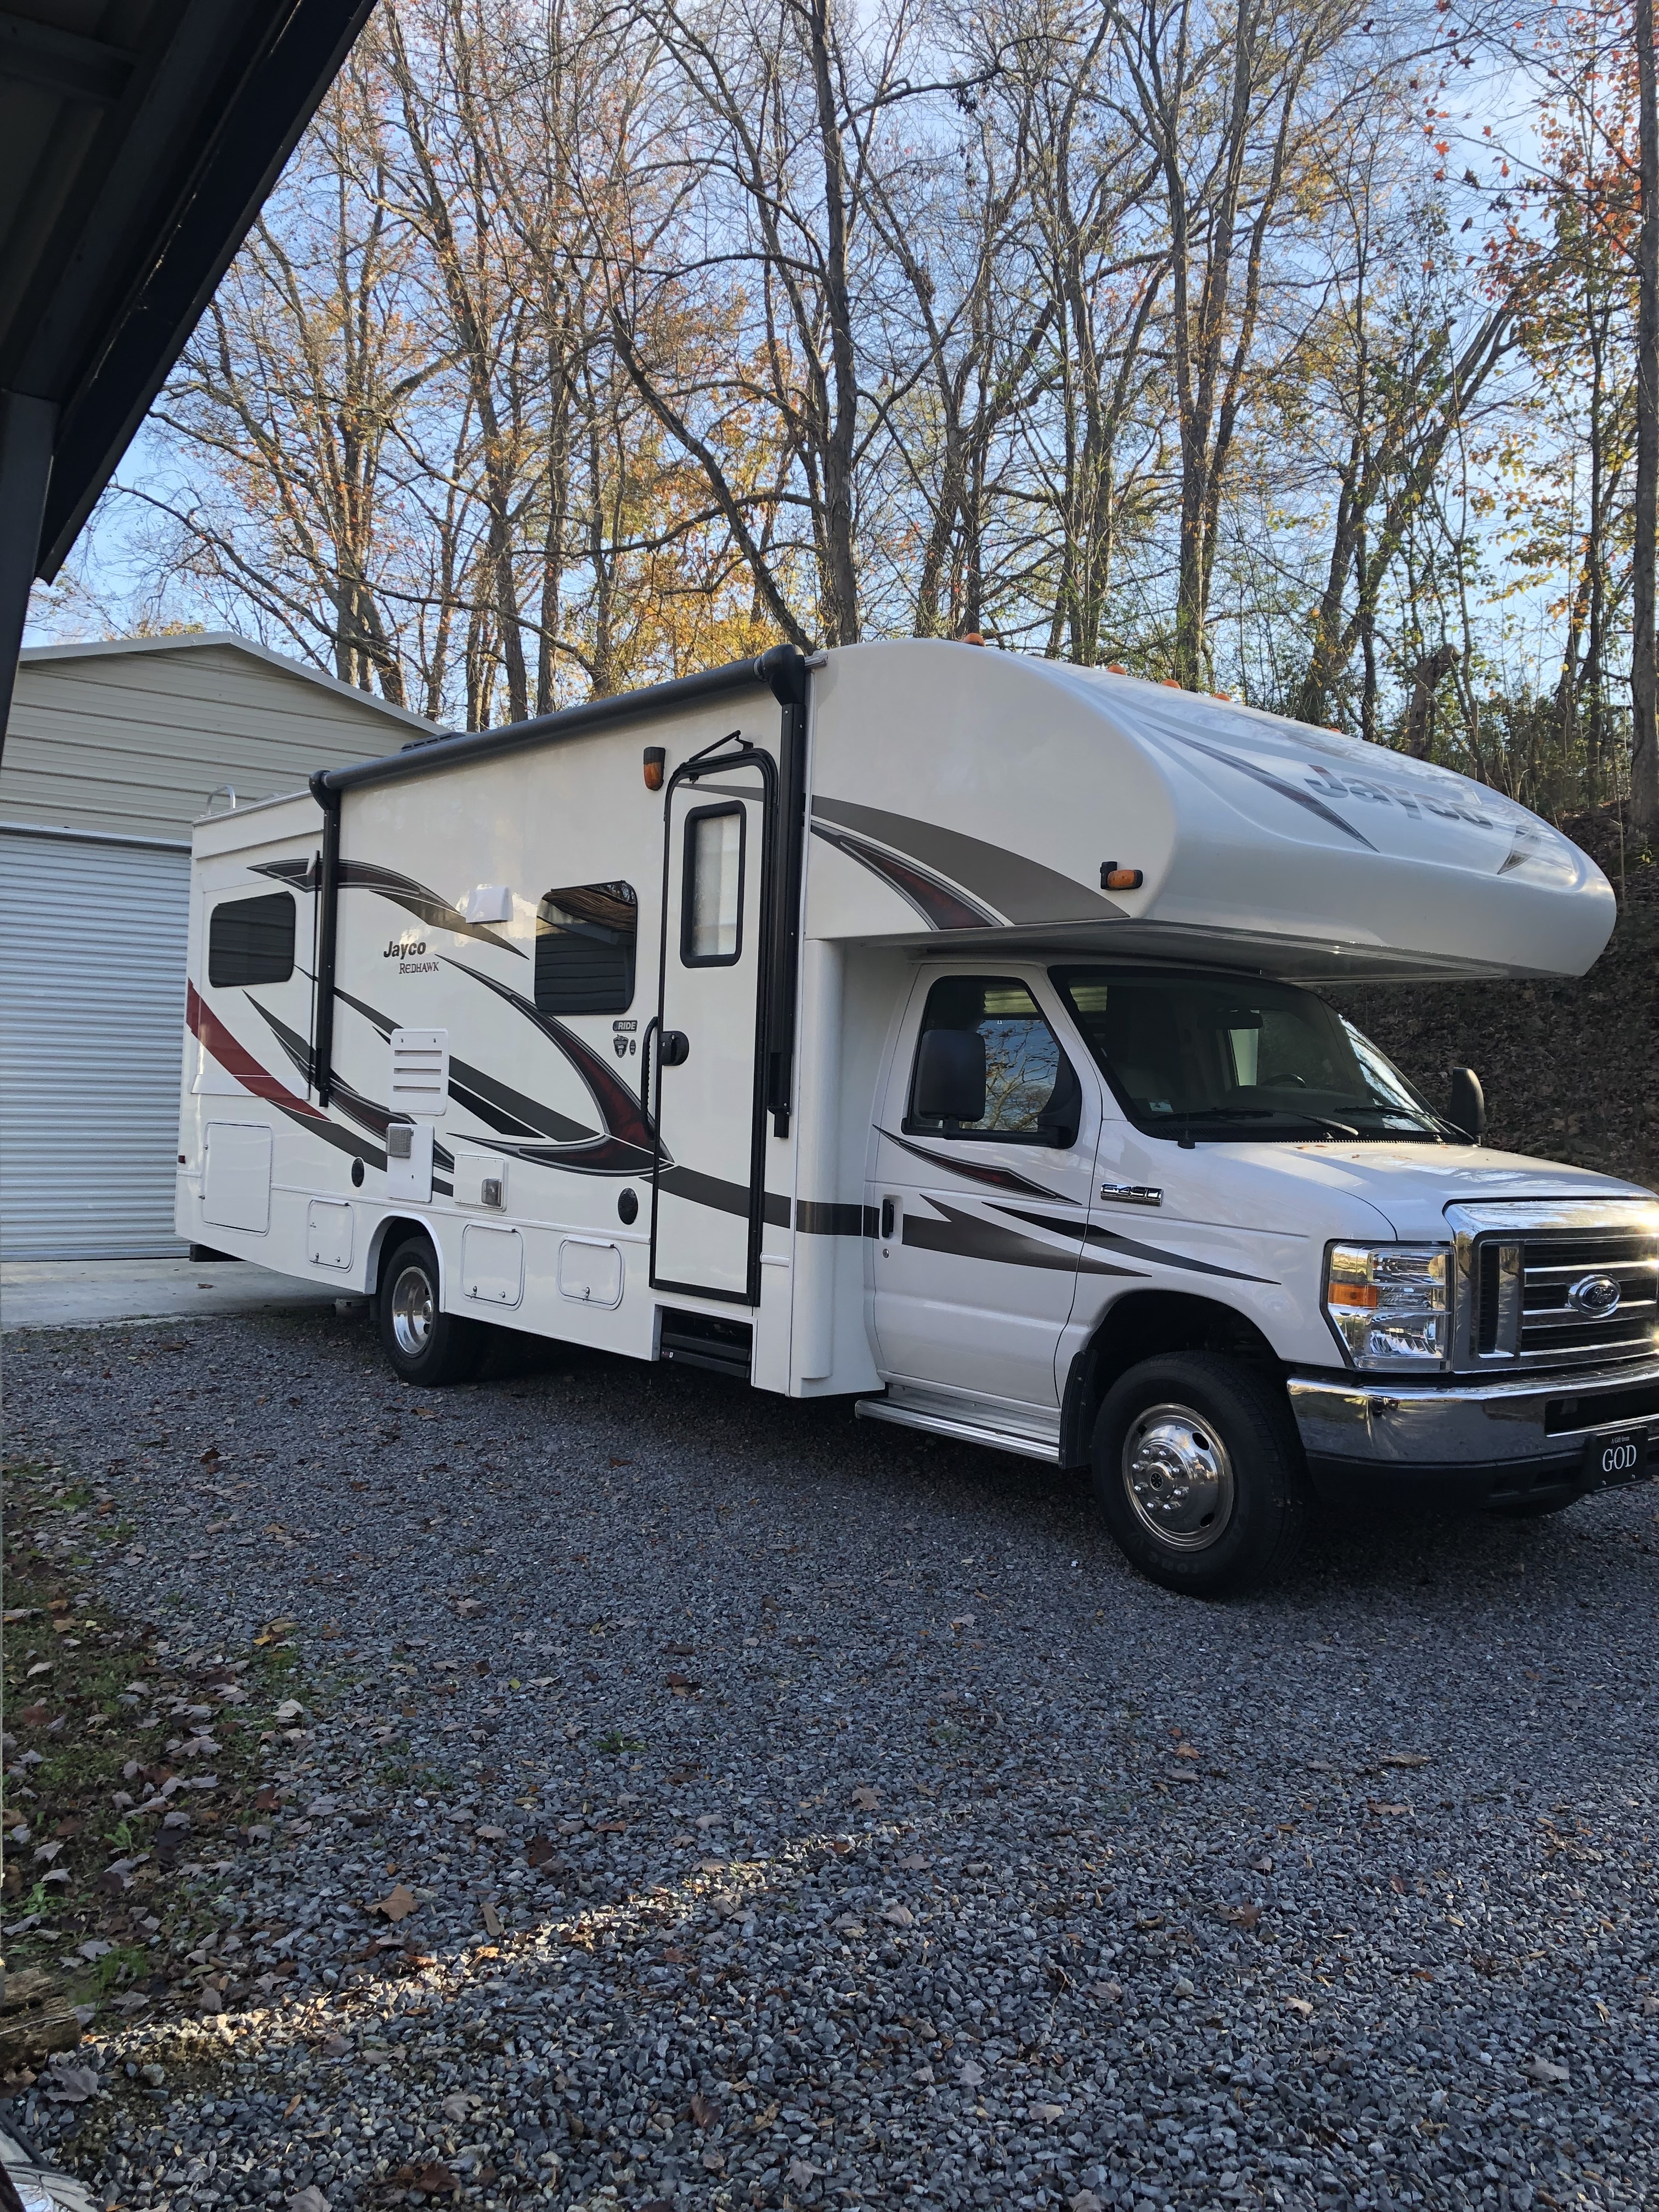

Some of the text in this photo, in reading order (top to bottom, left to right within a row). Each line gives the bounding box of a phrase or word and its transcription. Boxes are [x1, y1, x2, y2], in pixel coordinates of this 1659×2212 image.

[1304, 764, 1493, 830] Jayco
[383, 940, 426, 960] Jayco
[399, 962, 439, 974] REDHAWK
[1602, 1444, 1637, 1472] GOD
